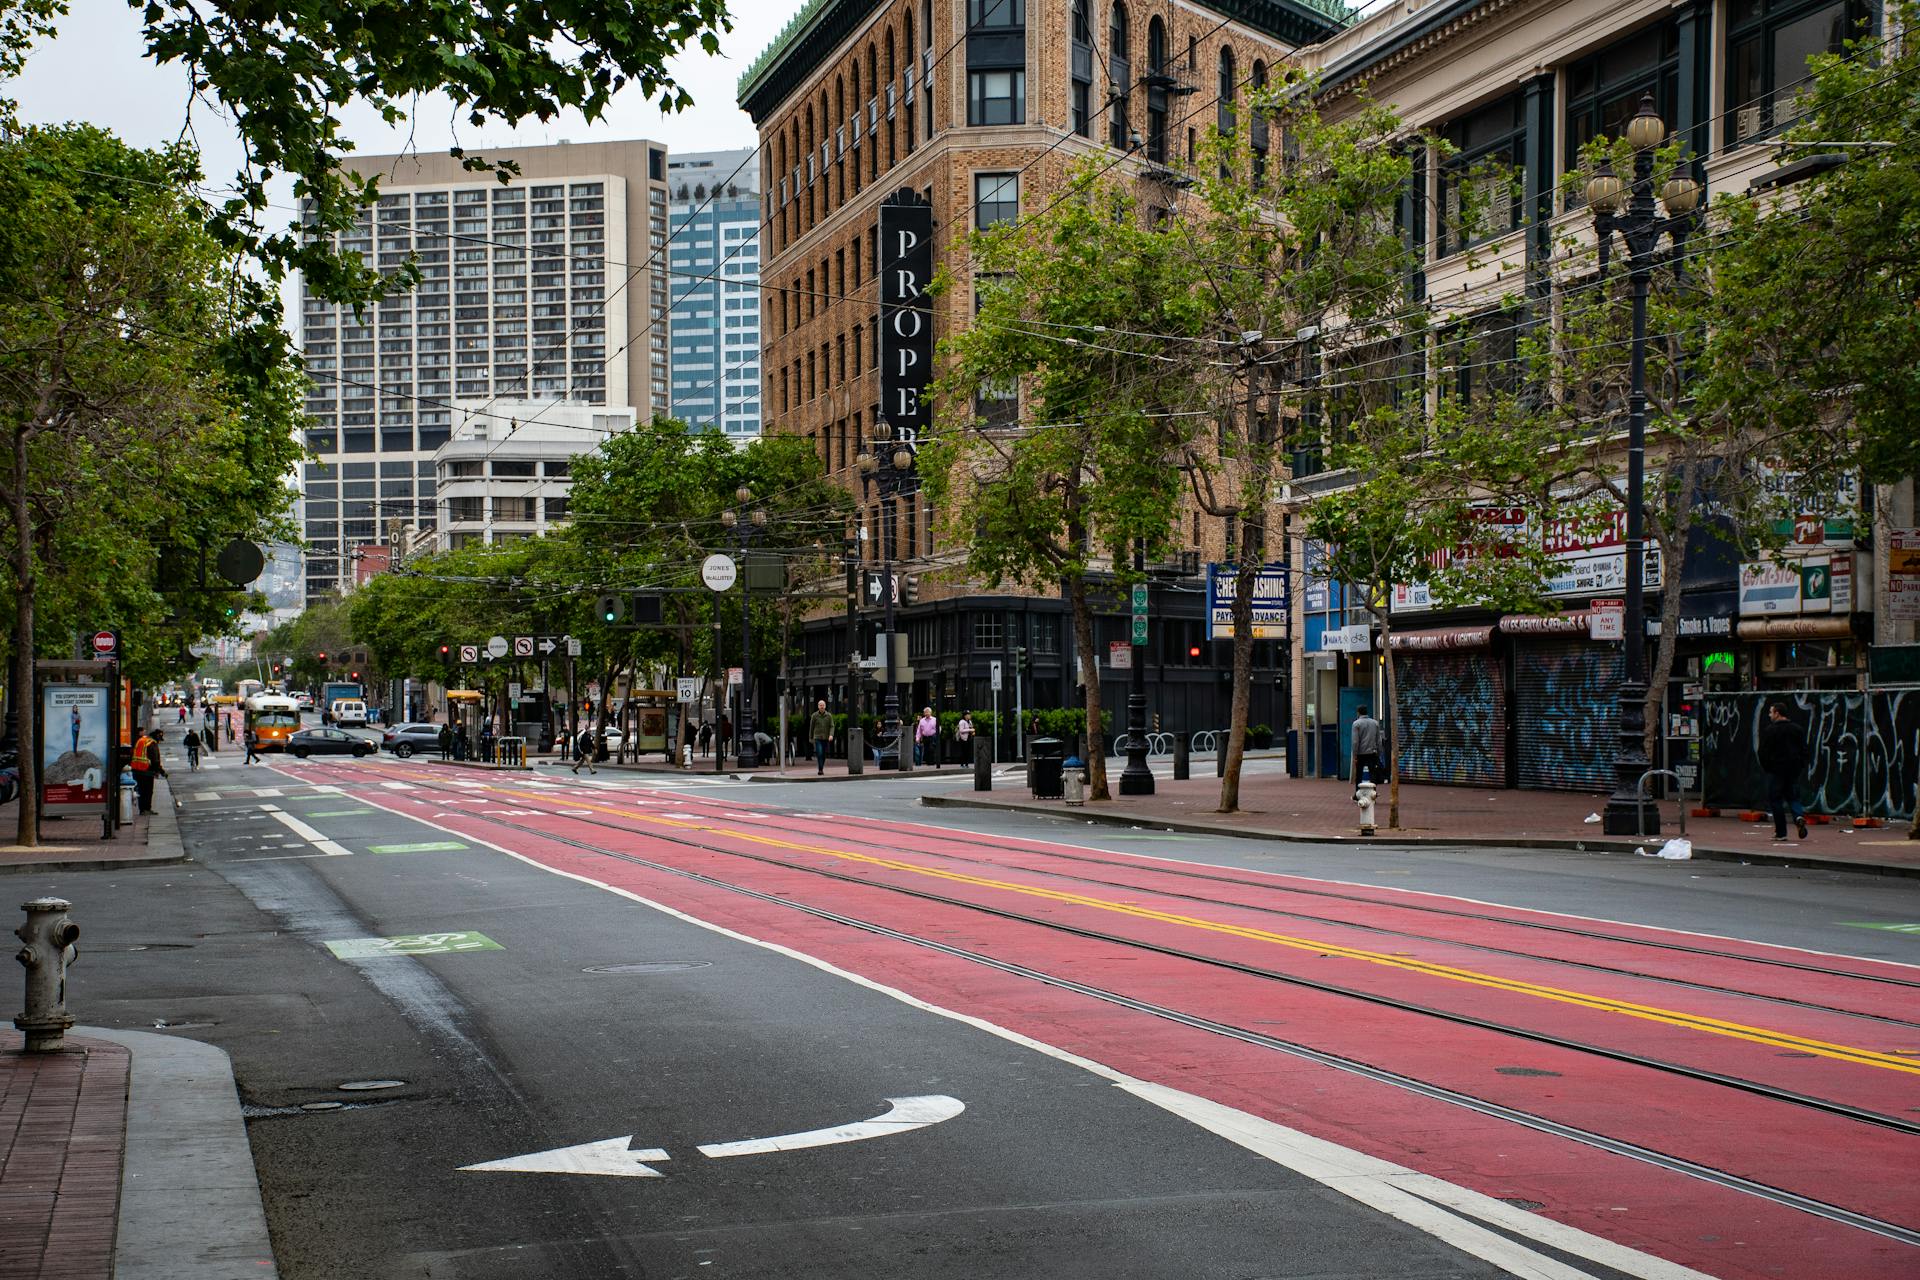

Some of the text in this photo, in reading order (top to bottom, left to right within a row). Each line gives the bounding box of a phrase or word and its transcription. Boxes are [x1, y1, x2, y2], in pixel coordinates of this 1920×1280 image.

[893, 229, 923, 455] PROPER
[1252, 577, 1286, 599] ASHING
[1891, 581, 1902, 592] NO
[1680, 617, 1702, 635] Smoke
[1709, 616, 1730, 635] Vapes
[681, 689, 692, 698] 10
